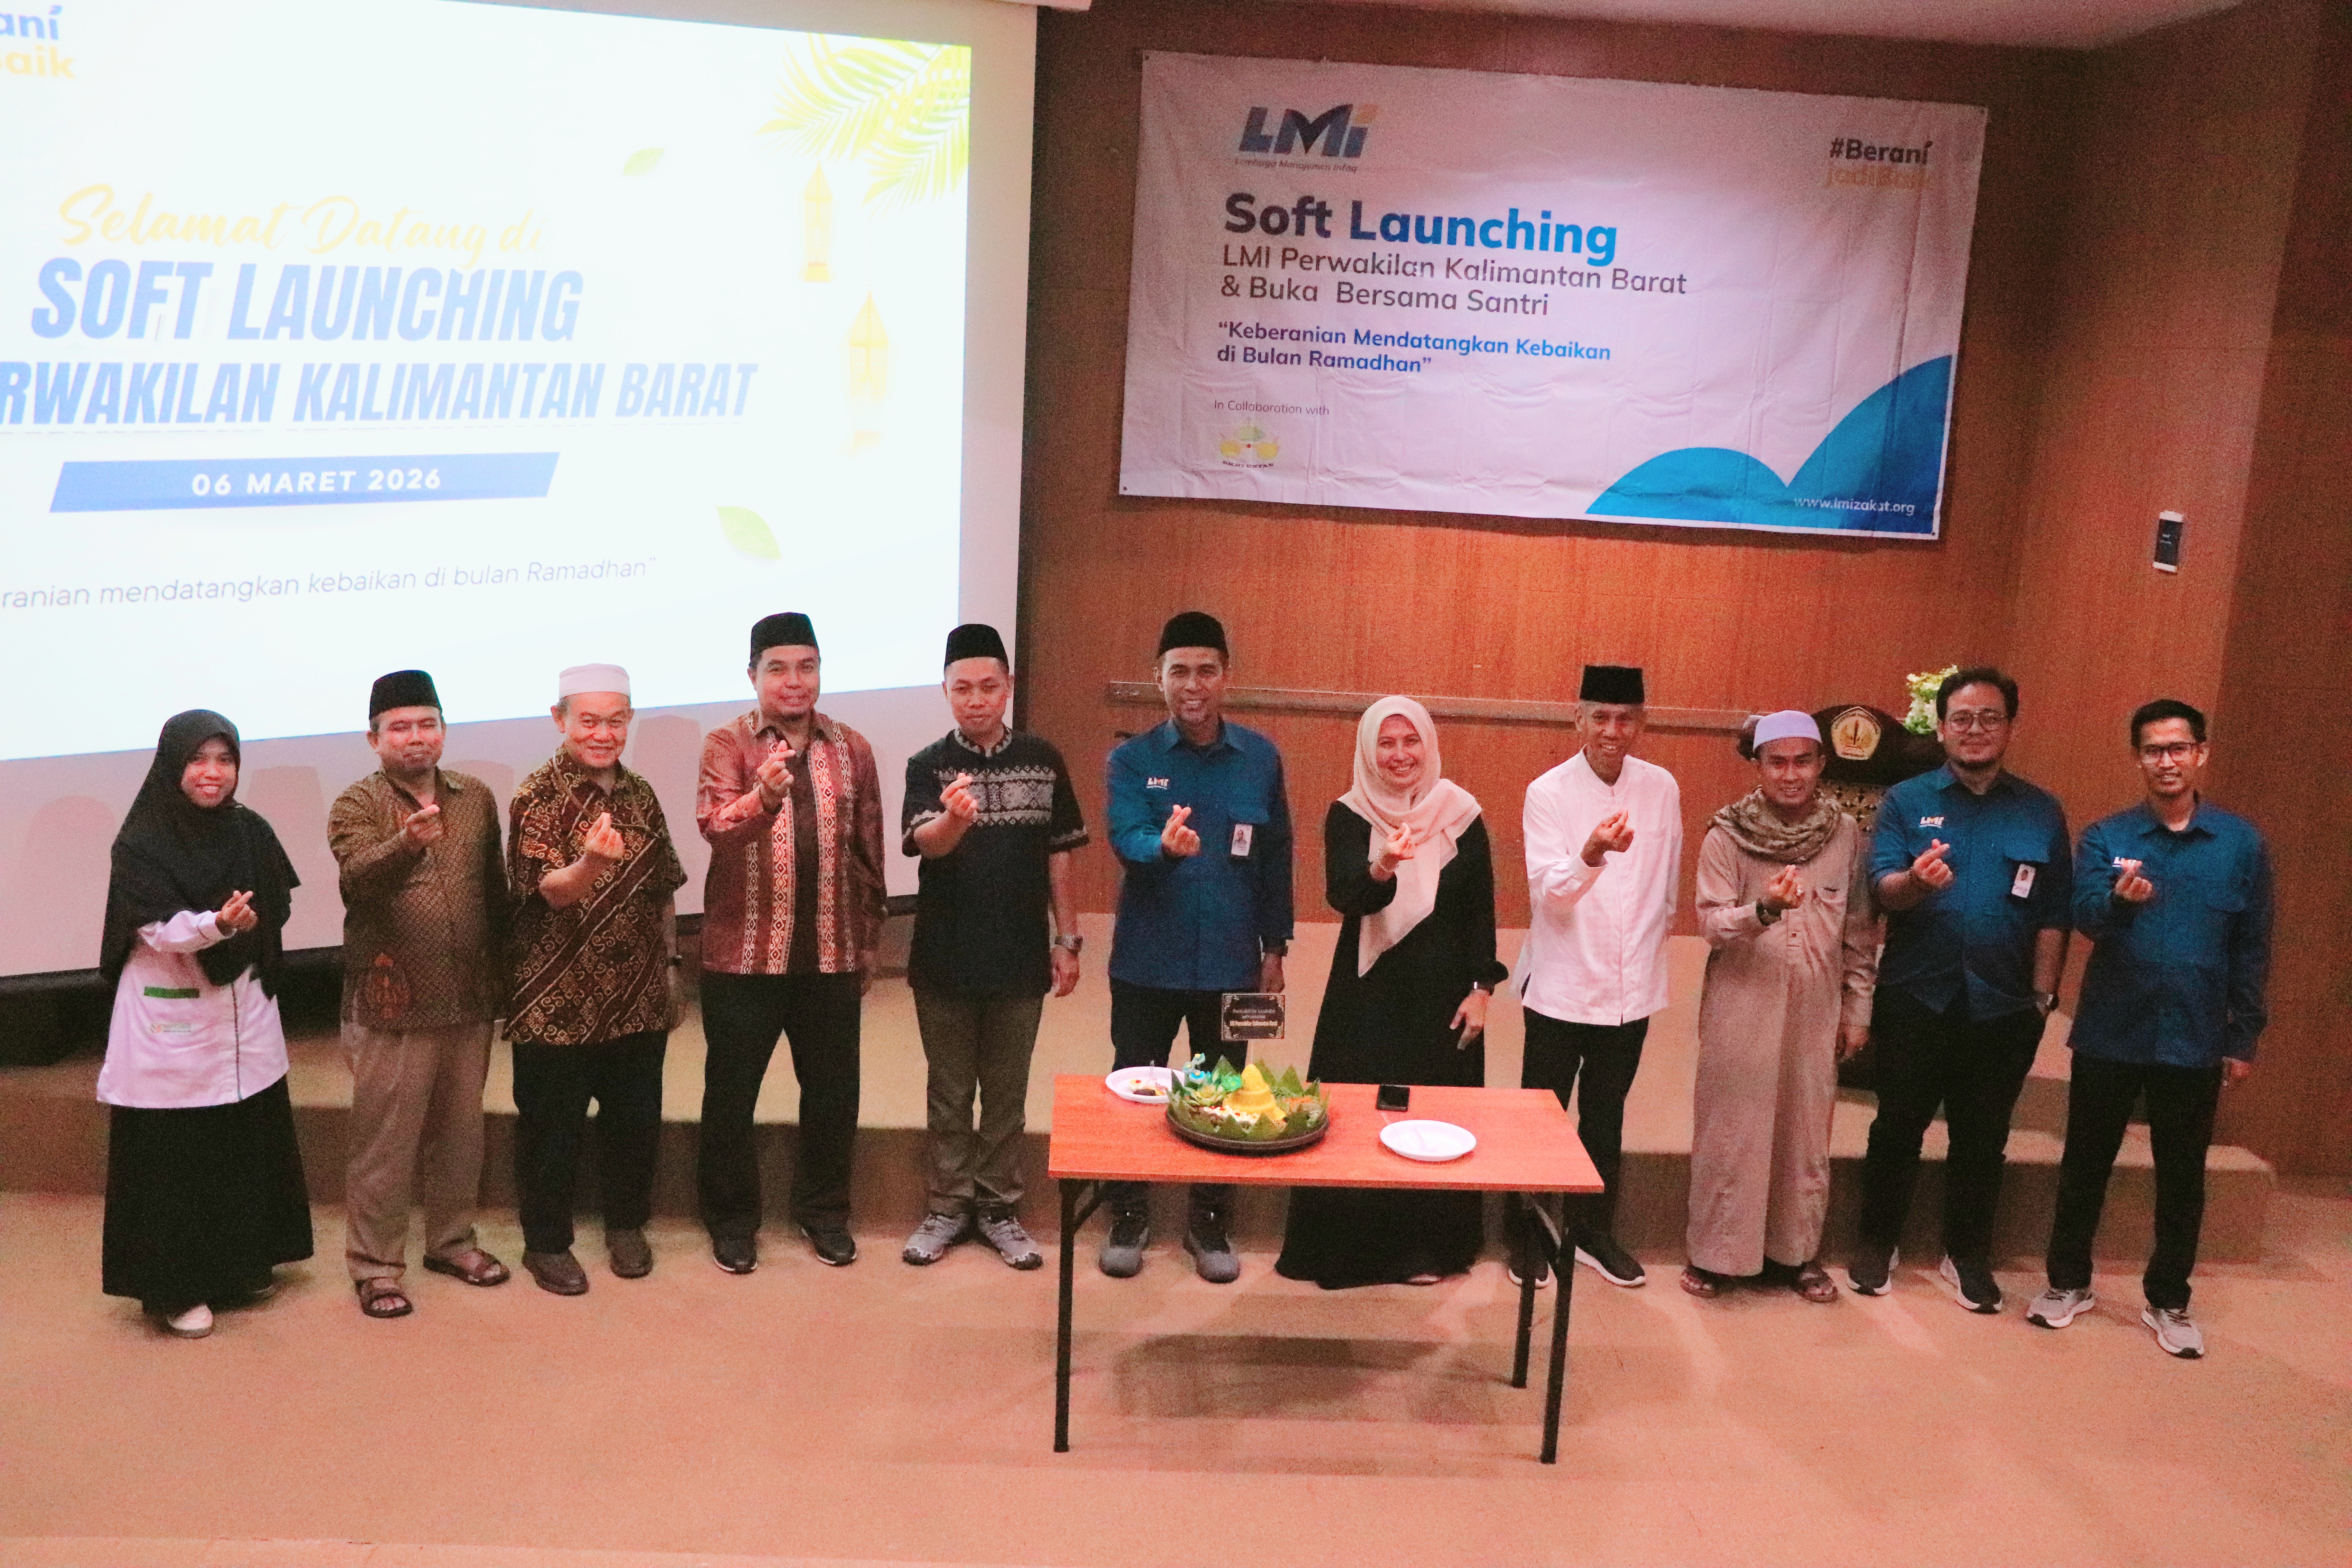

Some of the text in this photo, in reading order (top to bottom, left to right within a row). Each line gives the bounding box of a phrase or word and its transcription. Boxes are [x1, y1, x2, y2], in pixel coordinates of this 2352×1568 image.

[0, 44, 77, 80] aik
[59, 183, 548, 270] Selamat Datang di
[1224, 192, 1617, 267] Soft Launching
[1223, 244, 1687, 294] LMI Perwakilan Kalimantan Barat
[31, 257, 584, 341] SOFT LAUNCHING
[1221, 274, 1549, 315] & Buka Bersama Santri
[1218, 345, 1236, 363] di
[1243, 347, 1301, 365] Bulan
[1354, 329, 1508, 356] Mendatangkan
[1516, 338, 1610, 360] Kebaikan
[293, 363, 606, 423] KALIMANTAN
[615, 363, 759, 418] BARAT
[1214, 400, 1329, 416] In Collaboration with
[192, 468, 441, 496] 06 MARET 2026
[100, 575, 299, 604] mendatangkan
[309, 570, 416, 593] kebaikan
[425, 566, 445, 587] di
[454, 563, 519, 585] bulan
